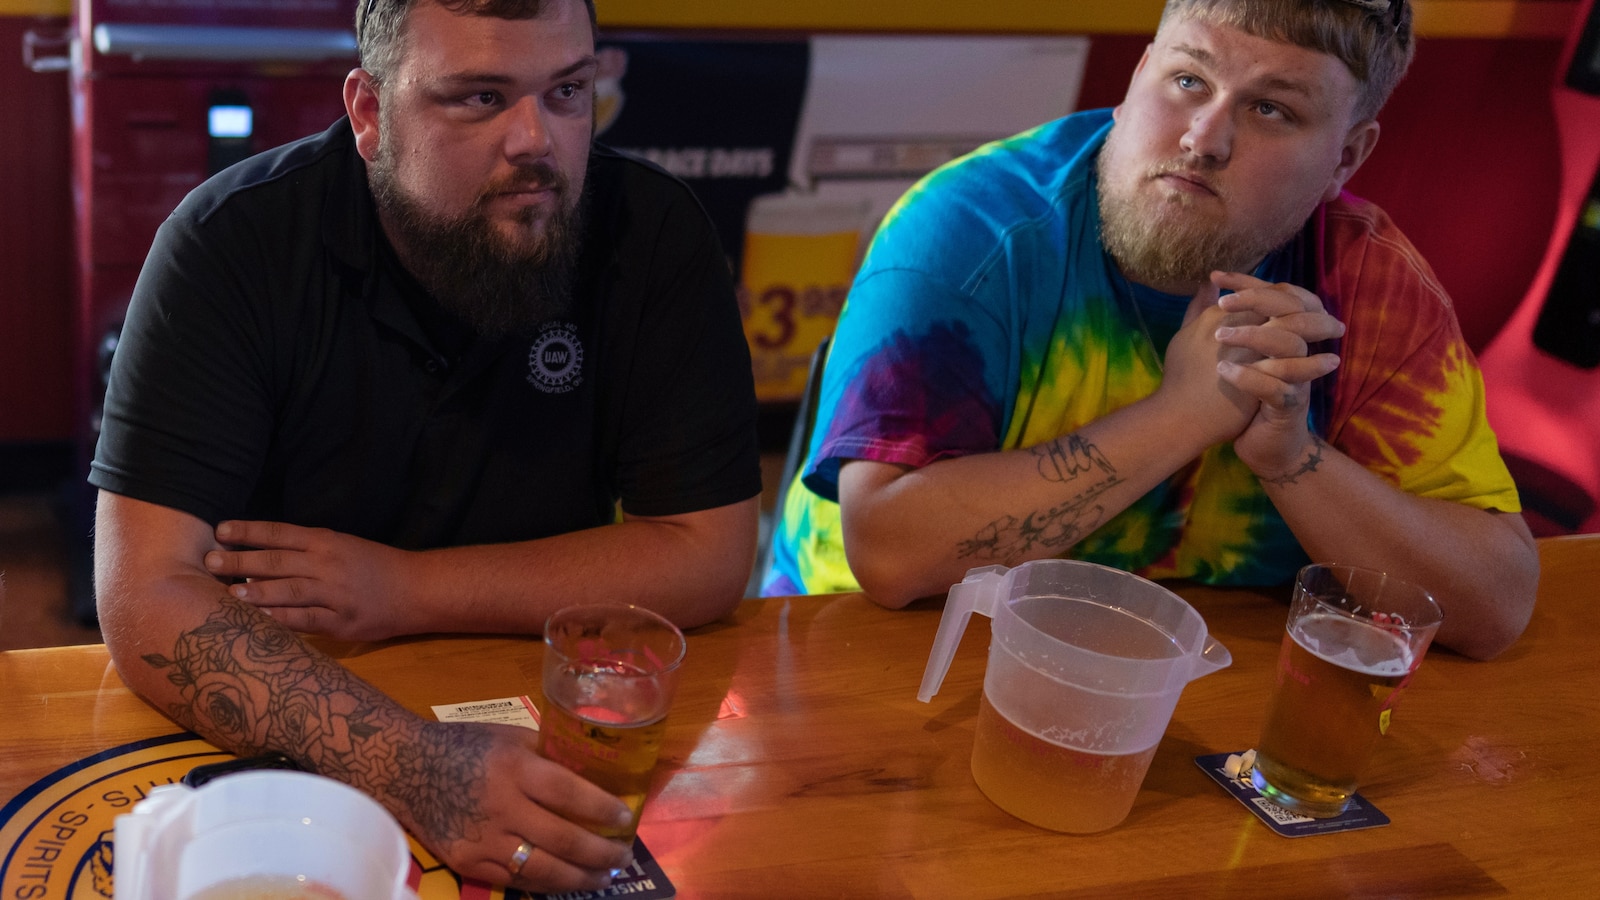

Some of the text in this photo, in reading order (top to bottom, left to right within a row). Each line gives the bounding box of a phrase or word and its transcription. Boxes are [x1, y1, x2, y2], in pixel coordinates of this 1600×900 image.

[711, 148, 774, 177] DAYS
[538, 321, 561, 332] LOCAL
[544, 351, 568, 364] UAW
[15, 810, 89, 900] SPIRITS
[610, 879, 657, 896] RAISE
